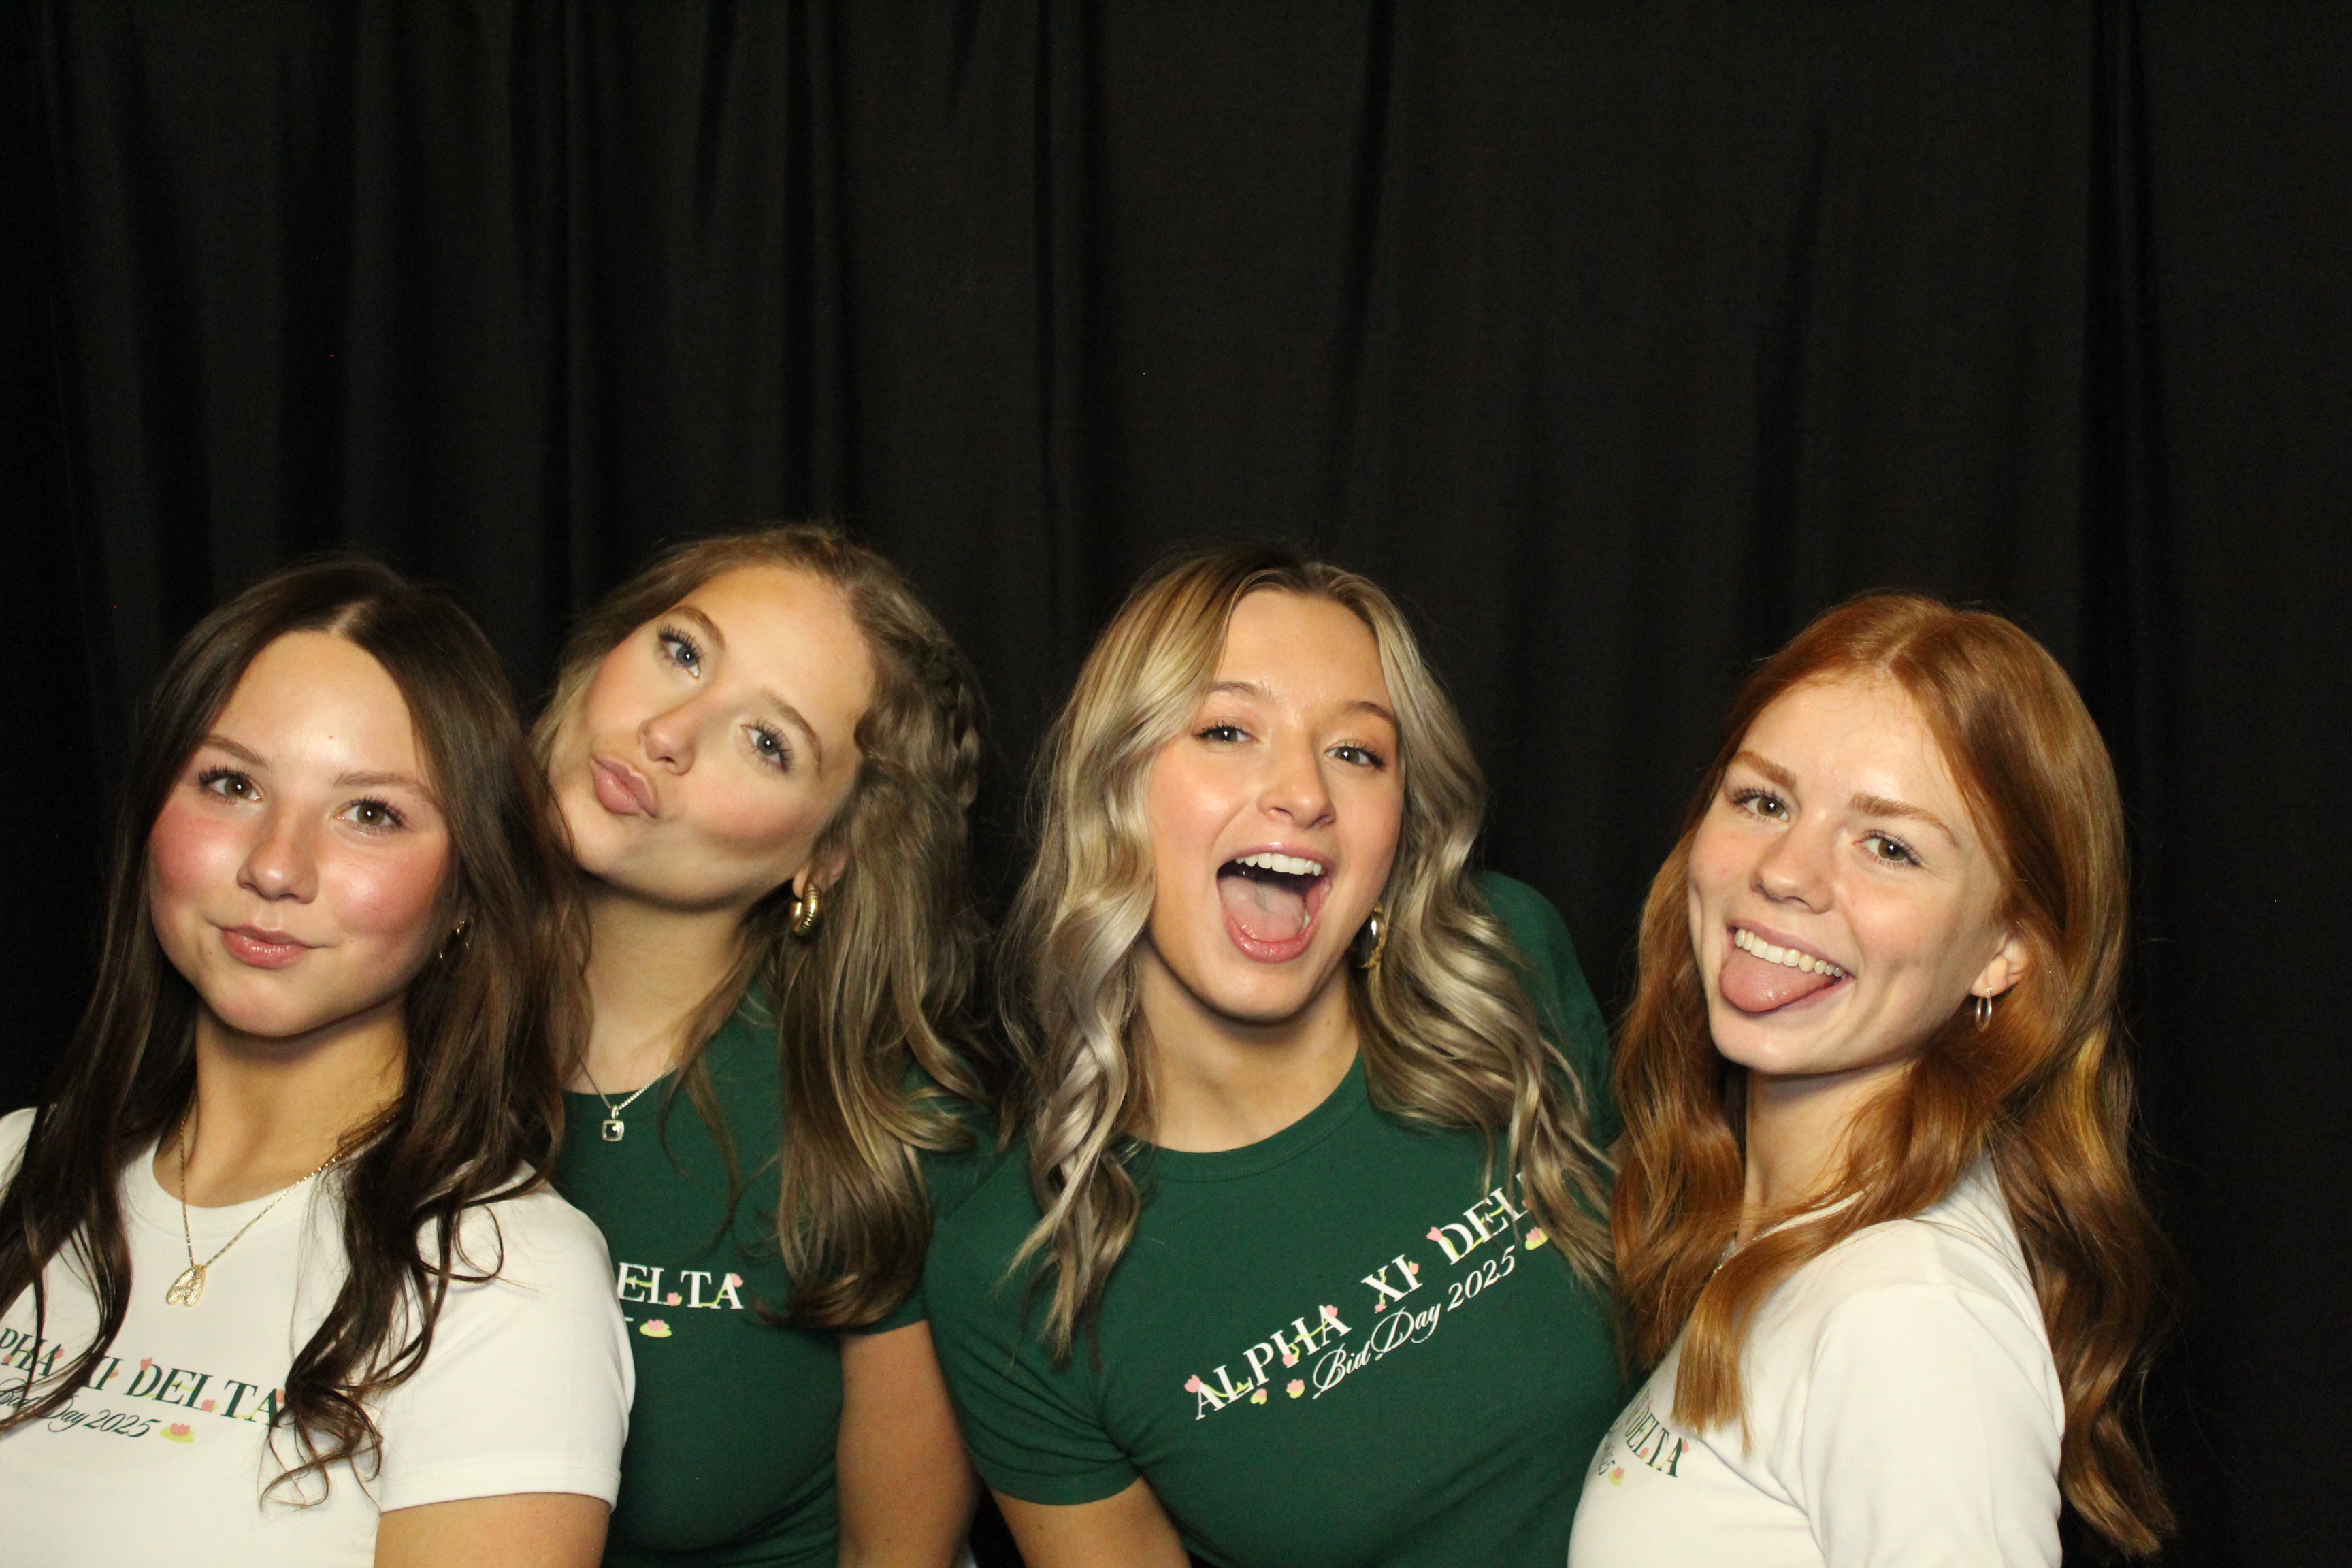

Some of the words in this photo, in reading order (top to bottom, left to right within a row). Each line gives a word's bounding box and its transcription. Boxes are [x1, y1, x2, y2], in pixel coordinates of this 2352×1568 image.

[1195, 1304, 1352, 1421] ALPHA
[1360, 1254, 1424, 1314] XI
[1432, 1172, 1529, 1267] DEL
[1311, 1341, 1371, 1400] Bid
[1371, 1303, 1441, 1361] Day
[1446, 1244, 1516, 1312] 2025
[82, 1409, 162, 1438] 2025
[123, 1362, 282, 1429] DELTA
